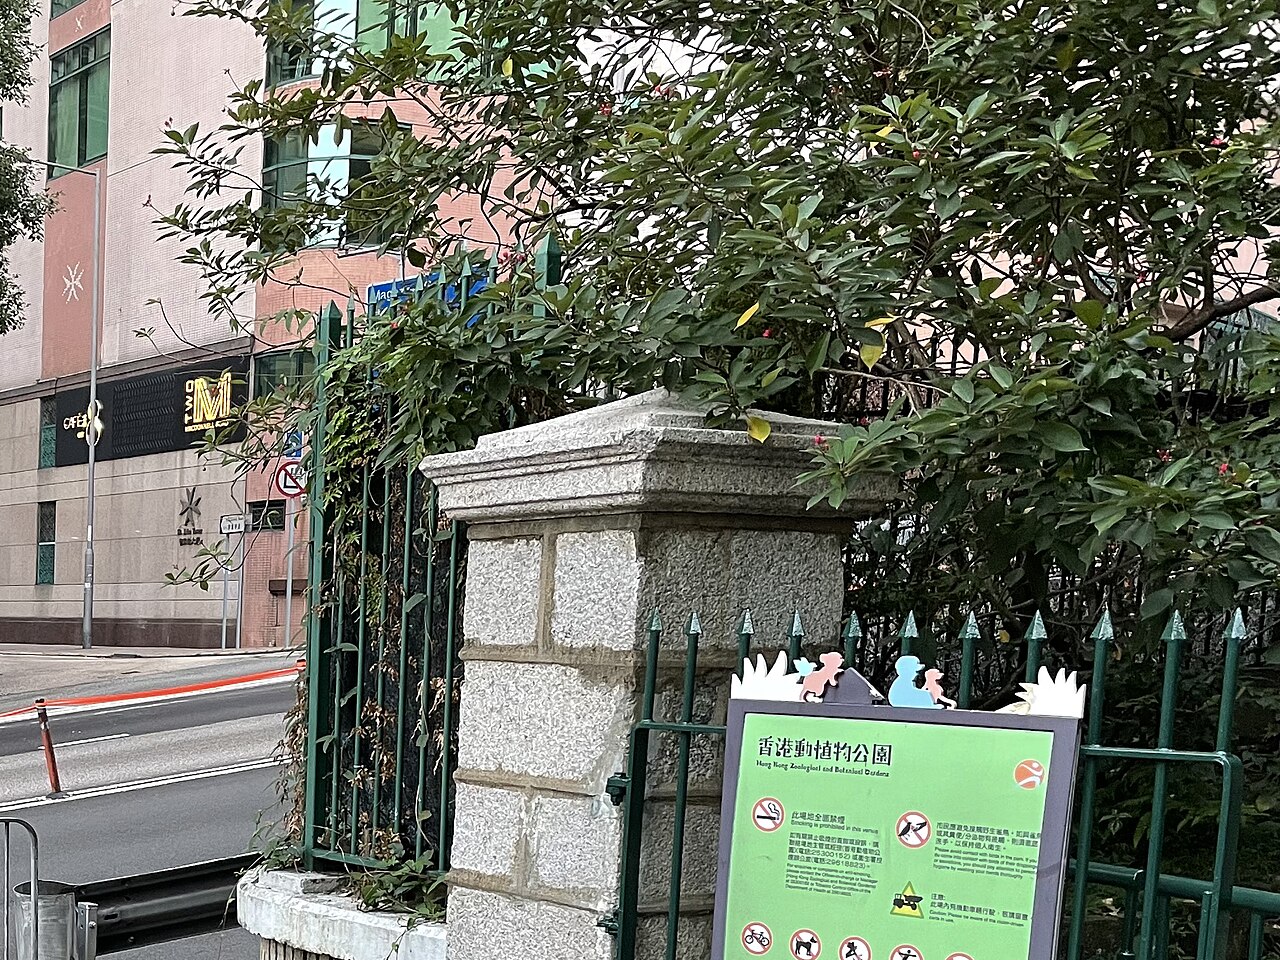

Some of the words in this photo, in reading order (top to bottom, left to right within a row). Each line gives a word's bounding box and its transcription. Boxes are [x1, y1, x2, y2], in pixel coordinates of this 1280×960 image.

[758, 735, 892, 766] 香港動植物公園
